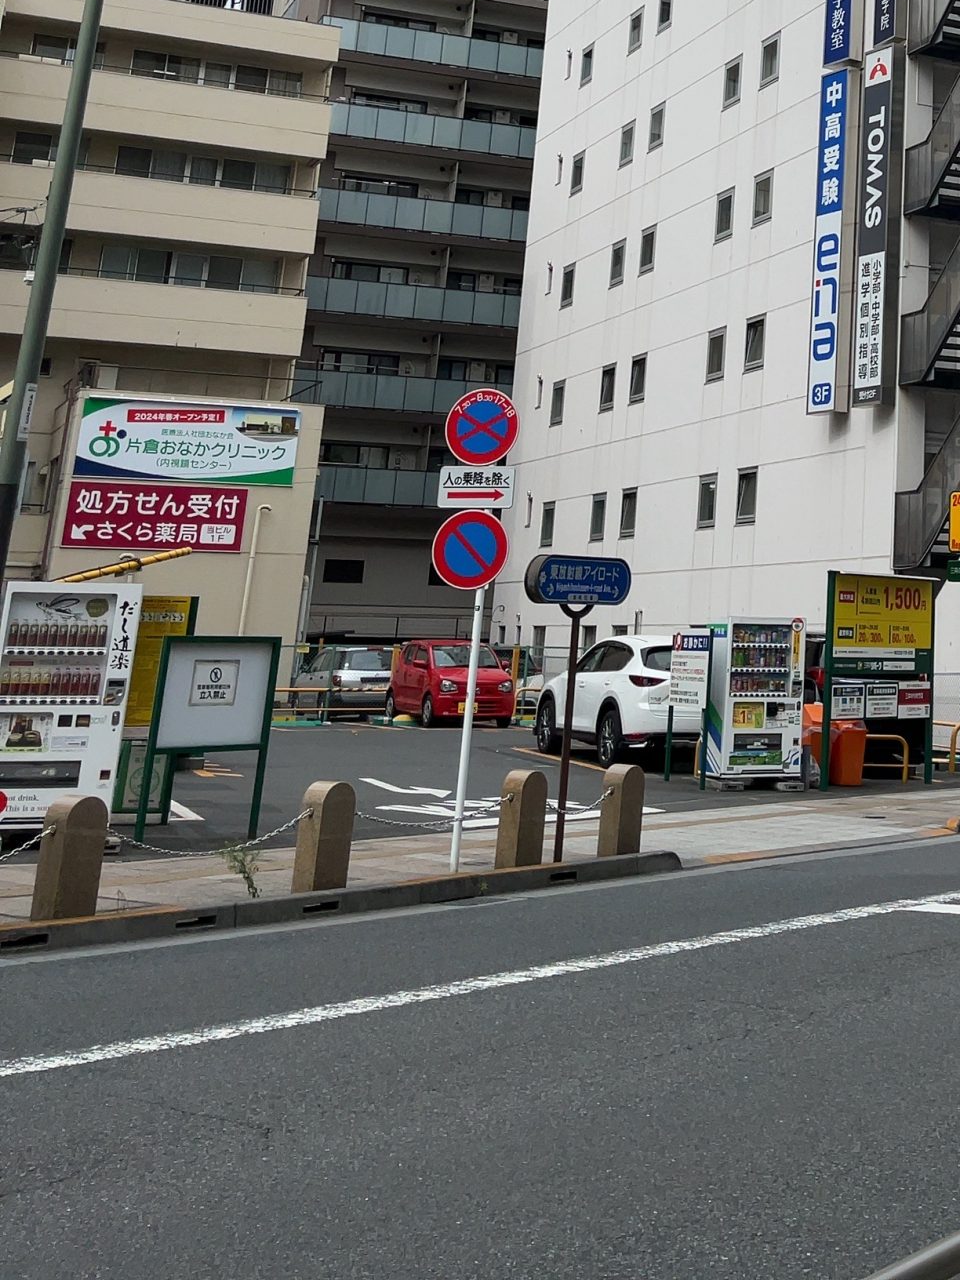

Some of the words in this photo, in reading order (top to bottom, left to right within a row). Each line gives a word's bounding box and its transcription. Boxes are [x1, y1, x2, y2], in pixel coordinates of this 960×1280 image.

[821, 81, 843, 216] 中高受験
[864, 105, 886, 229] TOMAS
[812, 232, 839, 363] ena
[858, 263, 871, 380] 進学個別指導
[869, 259, 881, 379] 小学部・中学部・高校部
[814, 386, 829, 402] 3F
[125, 438, 286, 461] 片倉おなかクリニック
[443, 472, 510, 486] 人の乗降を除く
[75, 488, 240, 520] 処方せん受付
[97, 520, 198, 544] さくら薬局
[206, 525, 231, 534] 当ビル
[110, 601, 138, 669] だし道楽
[199, 690, 226, 700] 立入禁止
